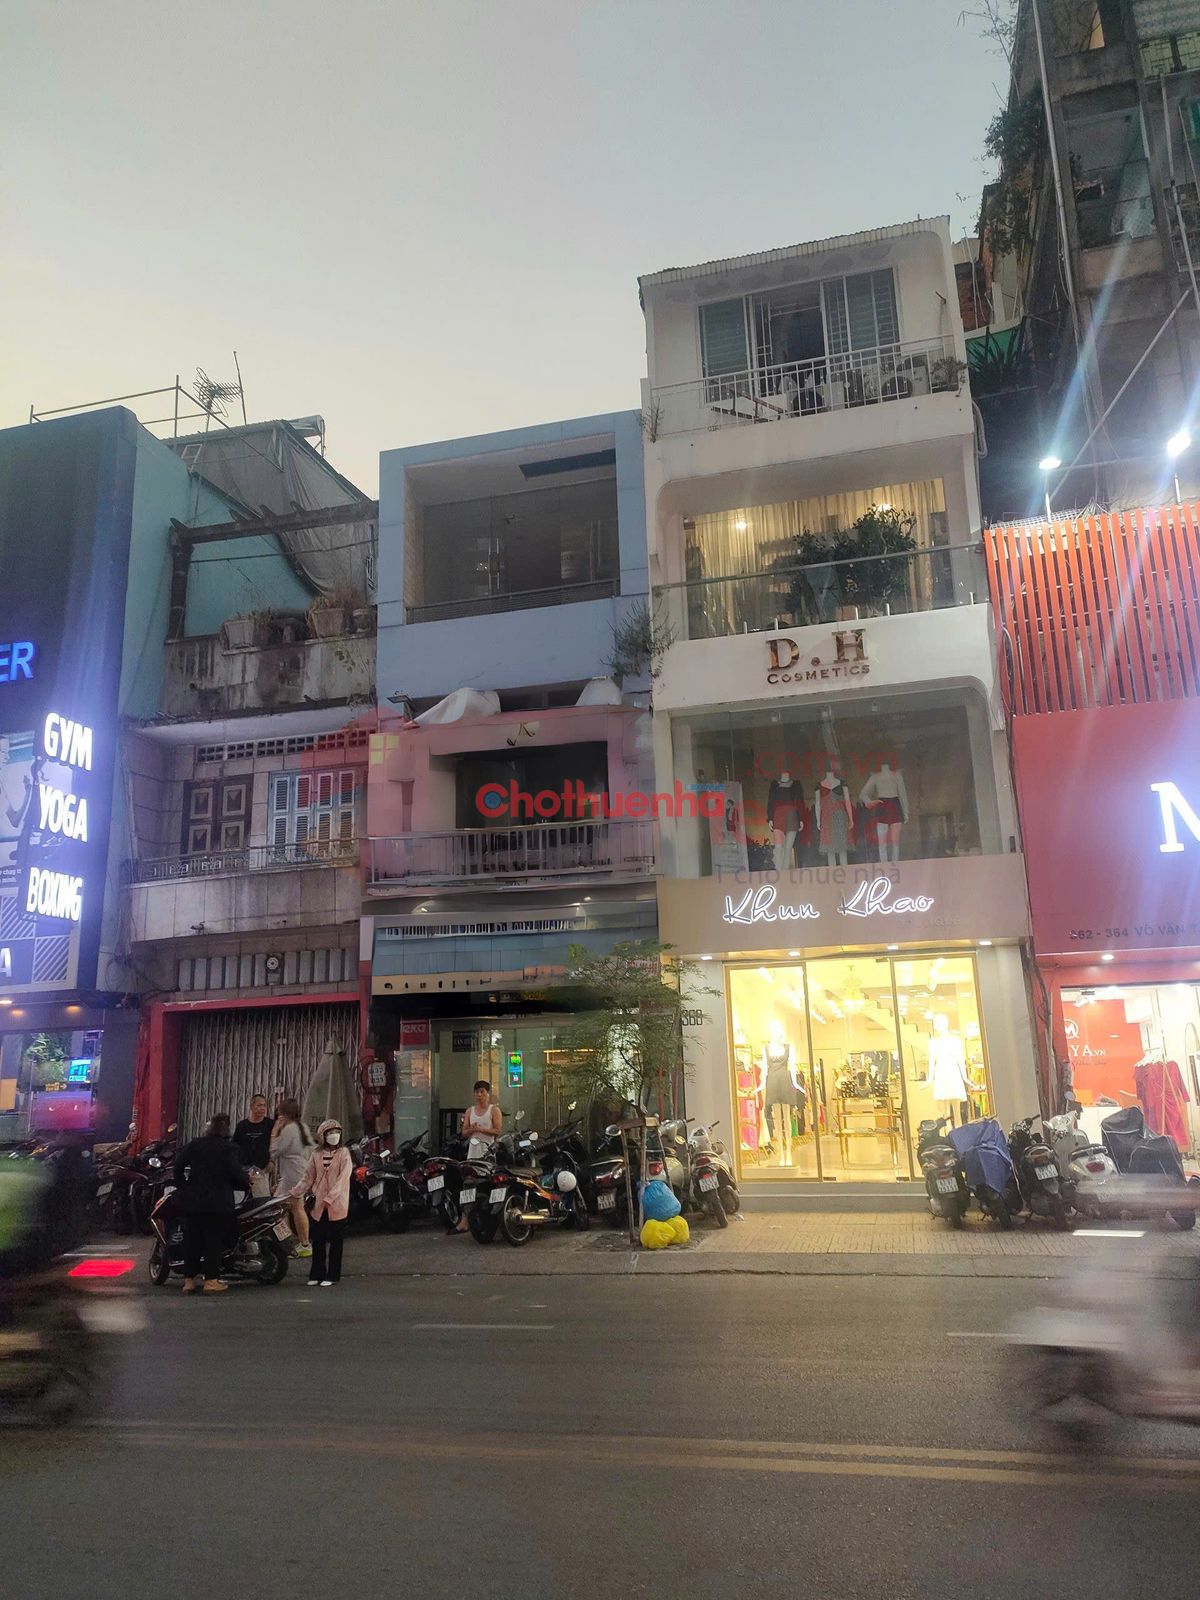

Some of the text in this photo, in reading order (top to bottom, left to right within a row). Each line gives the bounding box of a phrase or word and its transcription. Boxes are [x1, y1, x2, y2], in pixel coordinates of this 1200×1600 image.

[767, 665, 871, 684] COSMETICS
[44, 712, 92, 771] GYM
[39, 783, 88, 843] YOGA
[26, 867, 83, 921] BOXING
[722, 876, 935, 924] Khun Khao
[1105, 927, 1129, 938] 364
